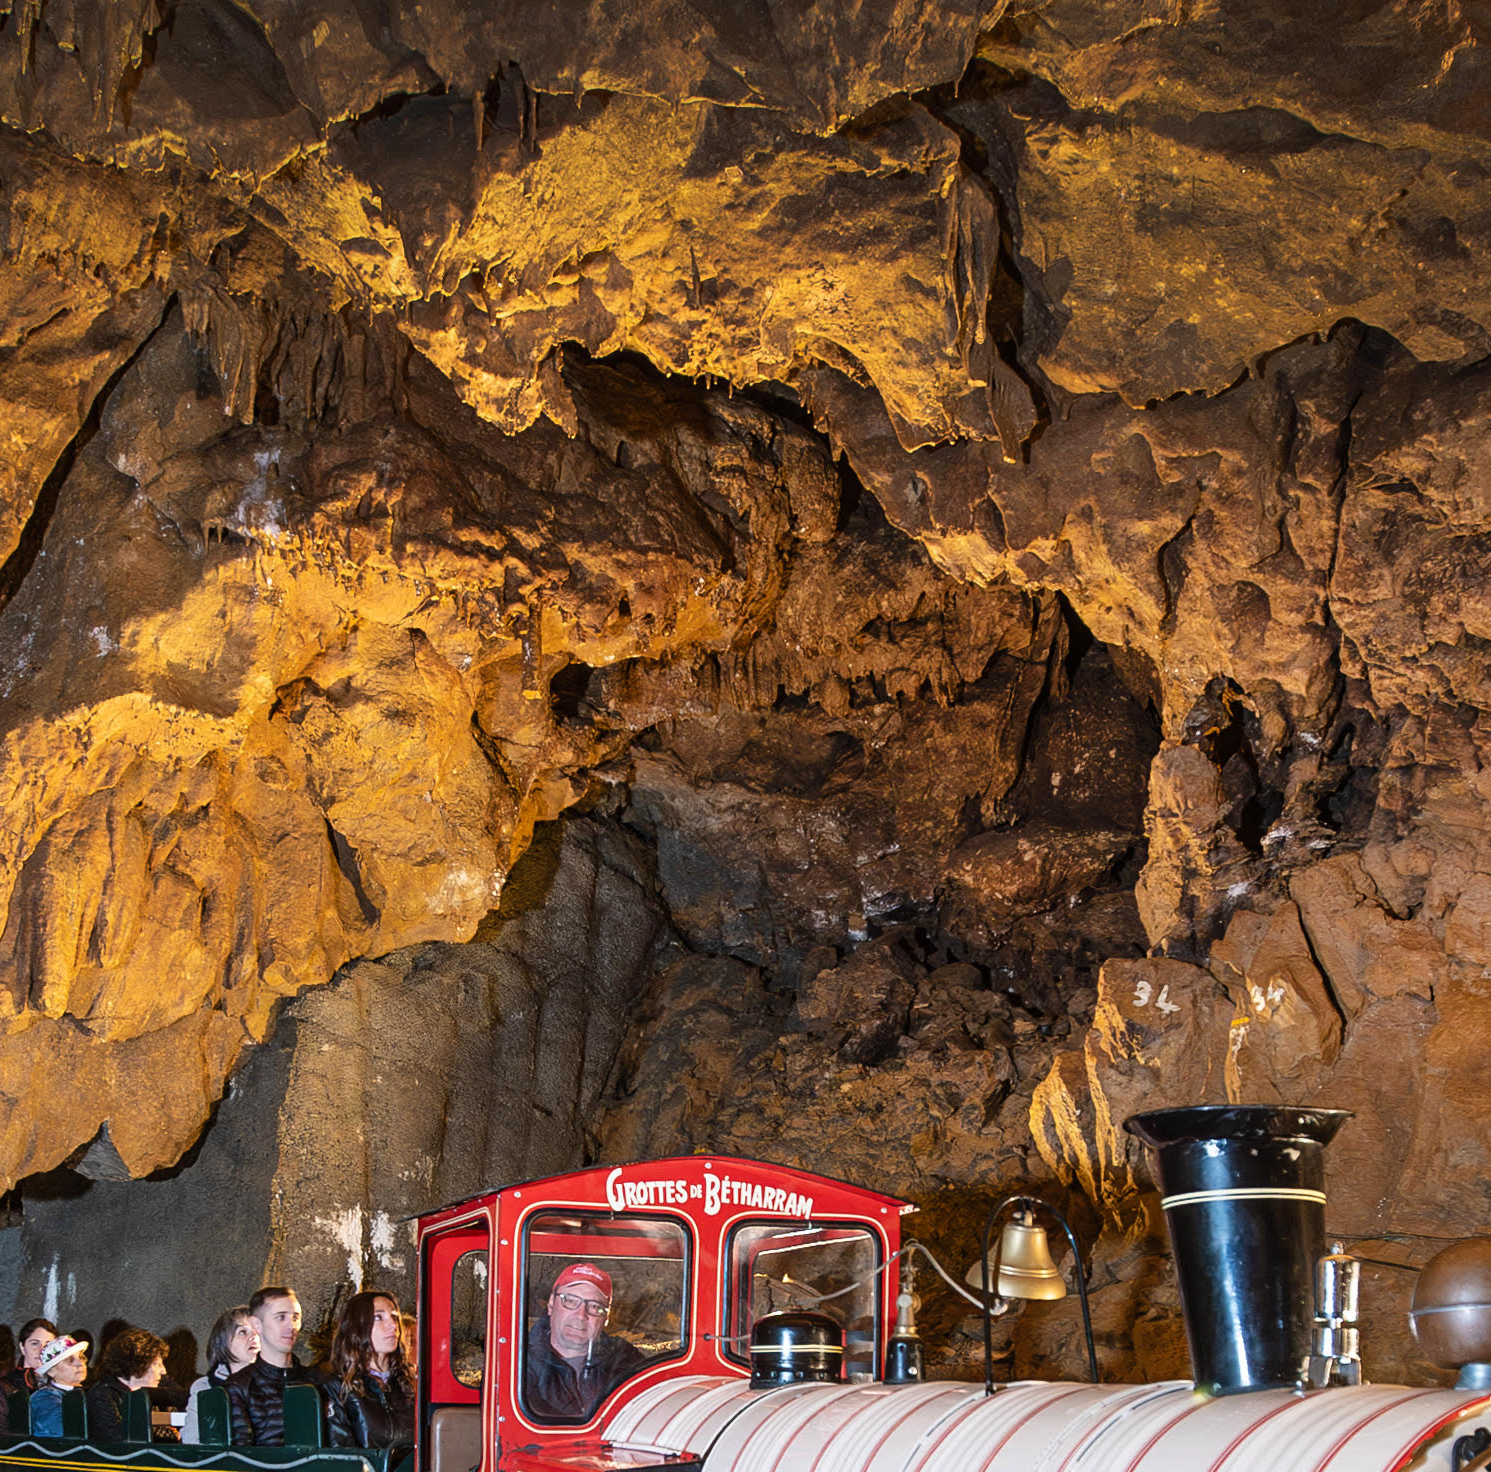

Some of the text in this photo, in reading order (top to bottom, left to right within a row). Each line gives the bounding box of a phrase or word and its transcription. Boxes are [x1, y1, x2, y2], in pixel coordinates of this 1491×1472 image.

[606, 1167, 813, 1220] GROTTES DE BÉTHARRAM
